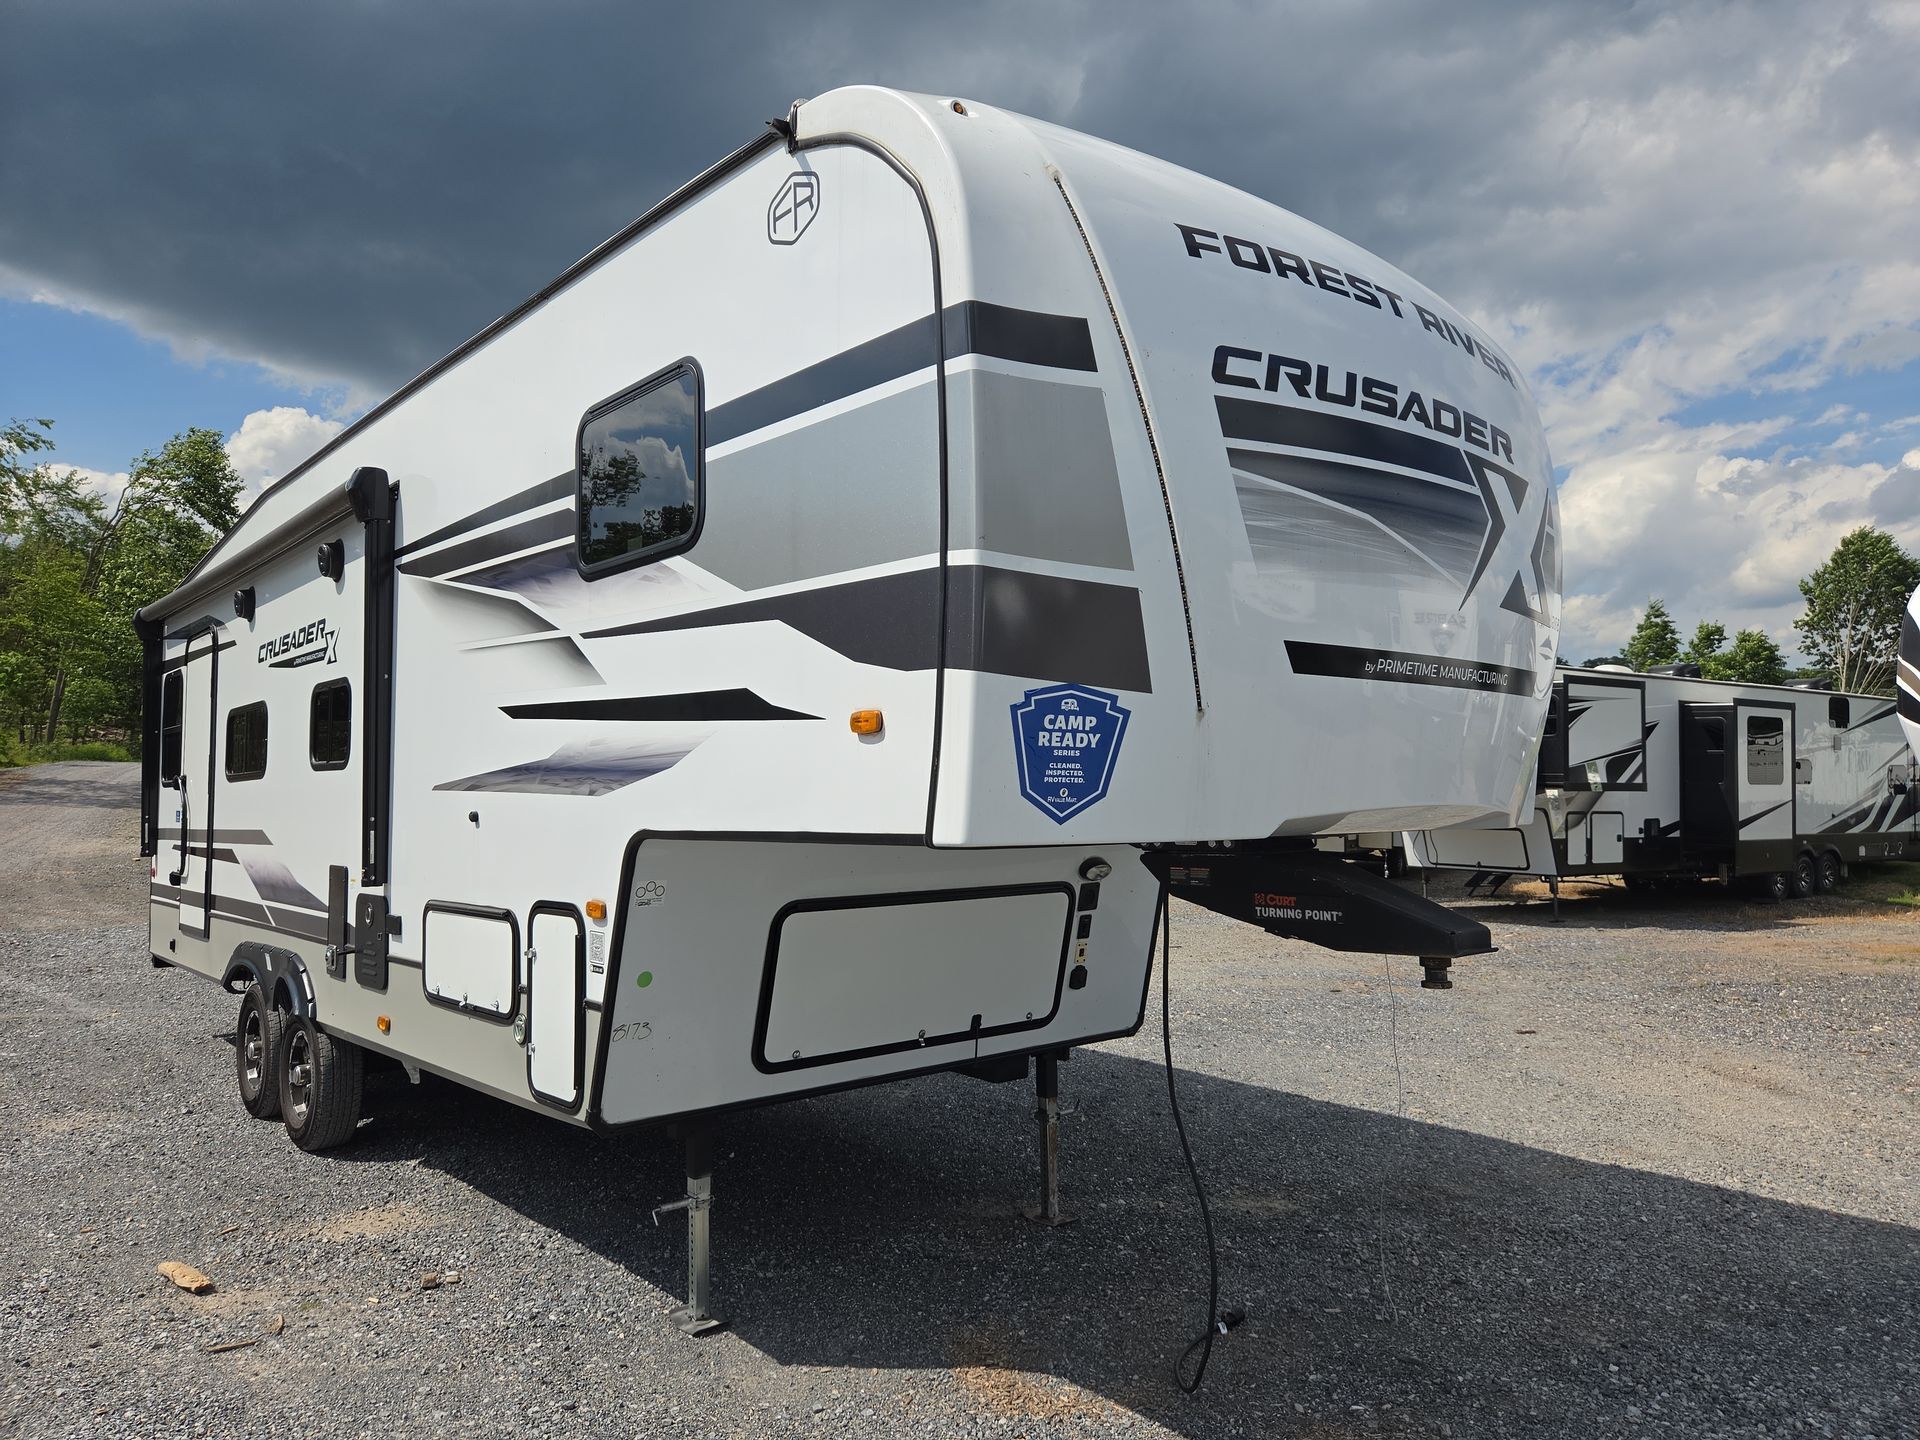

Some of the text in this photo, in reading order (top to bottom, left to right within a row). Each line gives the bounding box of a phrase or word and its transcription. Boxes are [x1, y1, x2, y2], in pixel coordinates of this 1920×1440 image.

[1174, 223, 1519, 391] FOREST RIVER
[1211, 345, 1515, 465] CRUSADER
[257, 618, 326, 664] CRUSADER
[1364, 658, 1509, 686] by PRIMETIME MANUFACTURING
[1043, 714, 1098, 731] CAMP
[1037, 731, 1101, 748] READY
[1053, 749, 1081, 757] SERIES
[1043, 776, 1086, 784] PROTECTED.
[1045, 769, 1085, 777] INSPECTED.
[1255, 906, 1303, 920] TURNING
[611, 1021, 653, 1043] 8173
